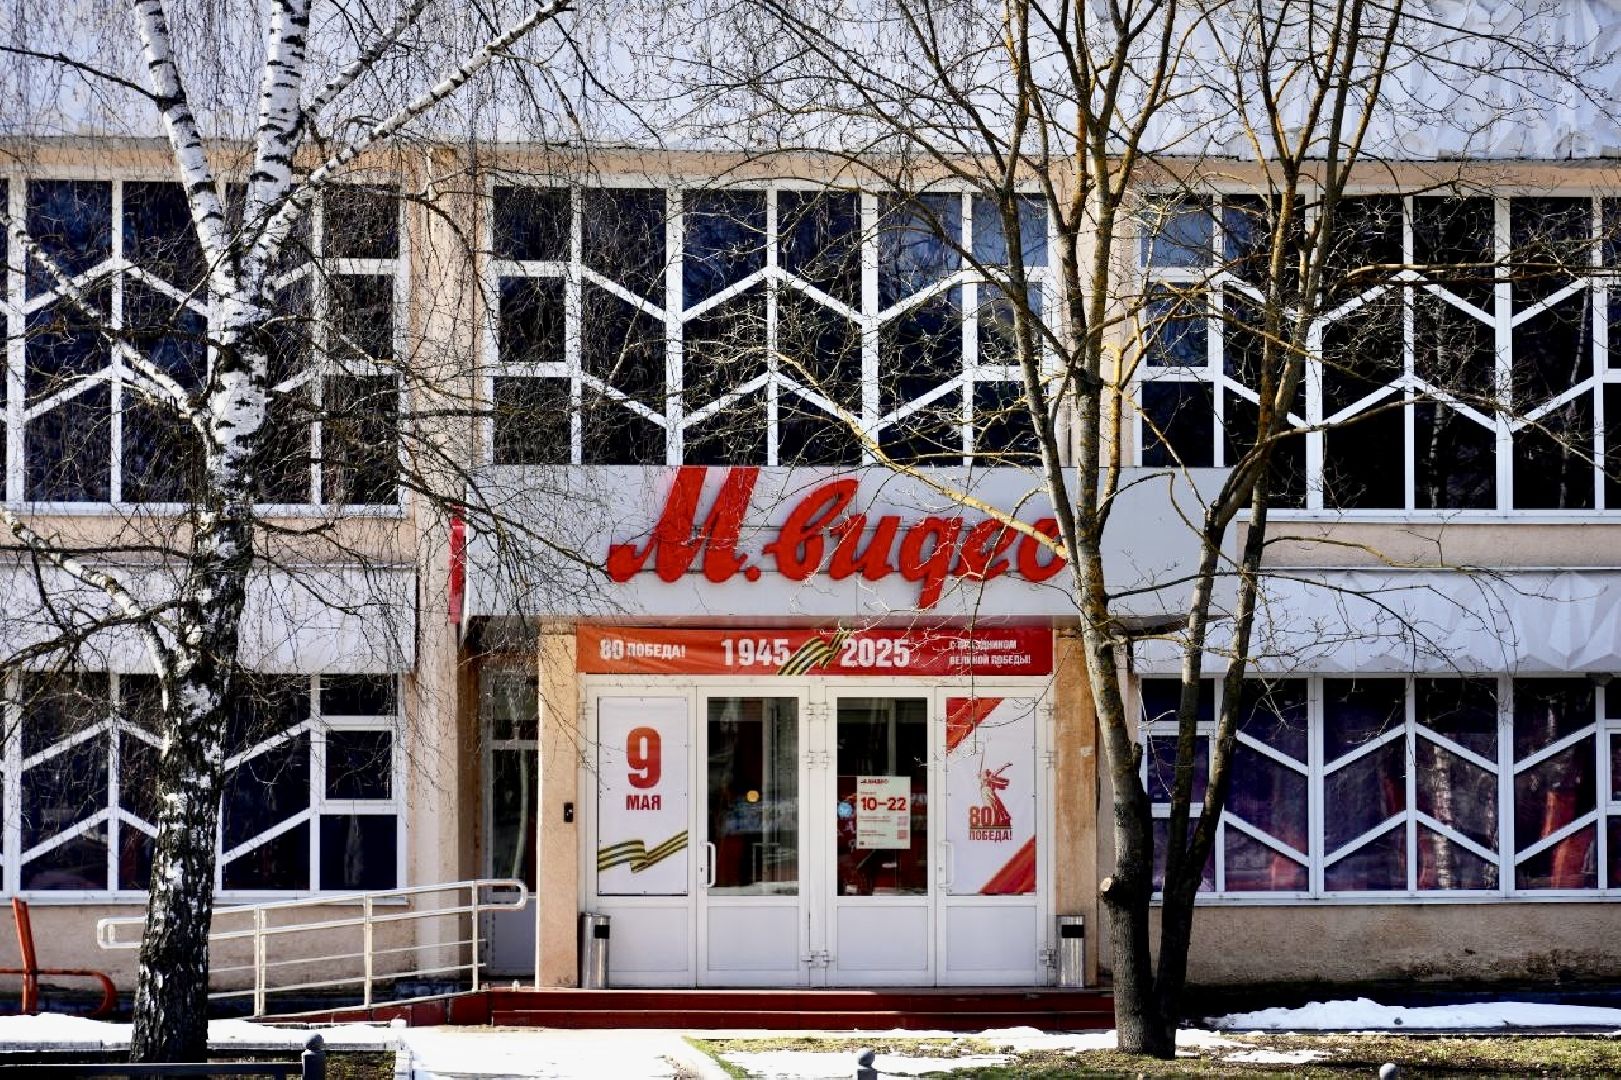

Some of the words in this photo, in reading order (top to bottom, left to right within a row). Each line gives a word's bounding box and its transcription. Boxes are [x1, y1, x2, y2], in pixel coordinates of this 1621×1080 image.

[600, 639, 624, 660] 80
[627, 643, 686, 660] ПОБЕДА!
[721, 638, 791, 666] 1945
[839, 638, 911, 668] 2025
[991, 654, 1031, 666] ПОБЕДЫ!
[626, 725, 662, 789] 9
[625, 795, 662, 811] МАЯ
[969, 805, 992, 827] 80
[969, 830, 1012, 844] ПОБЕДА!
